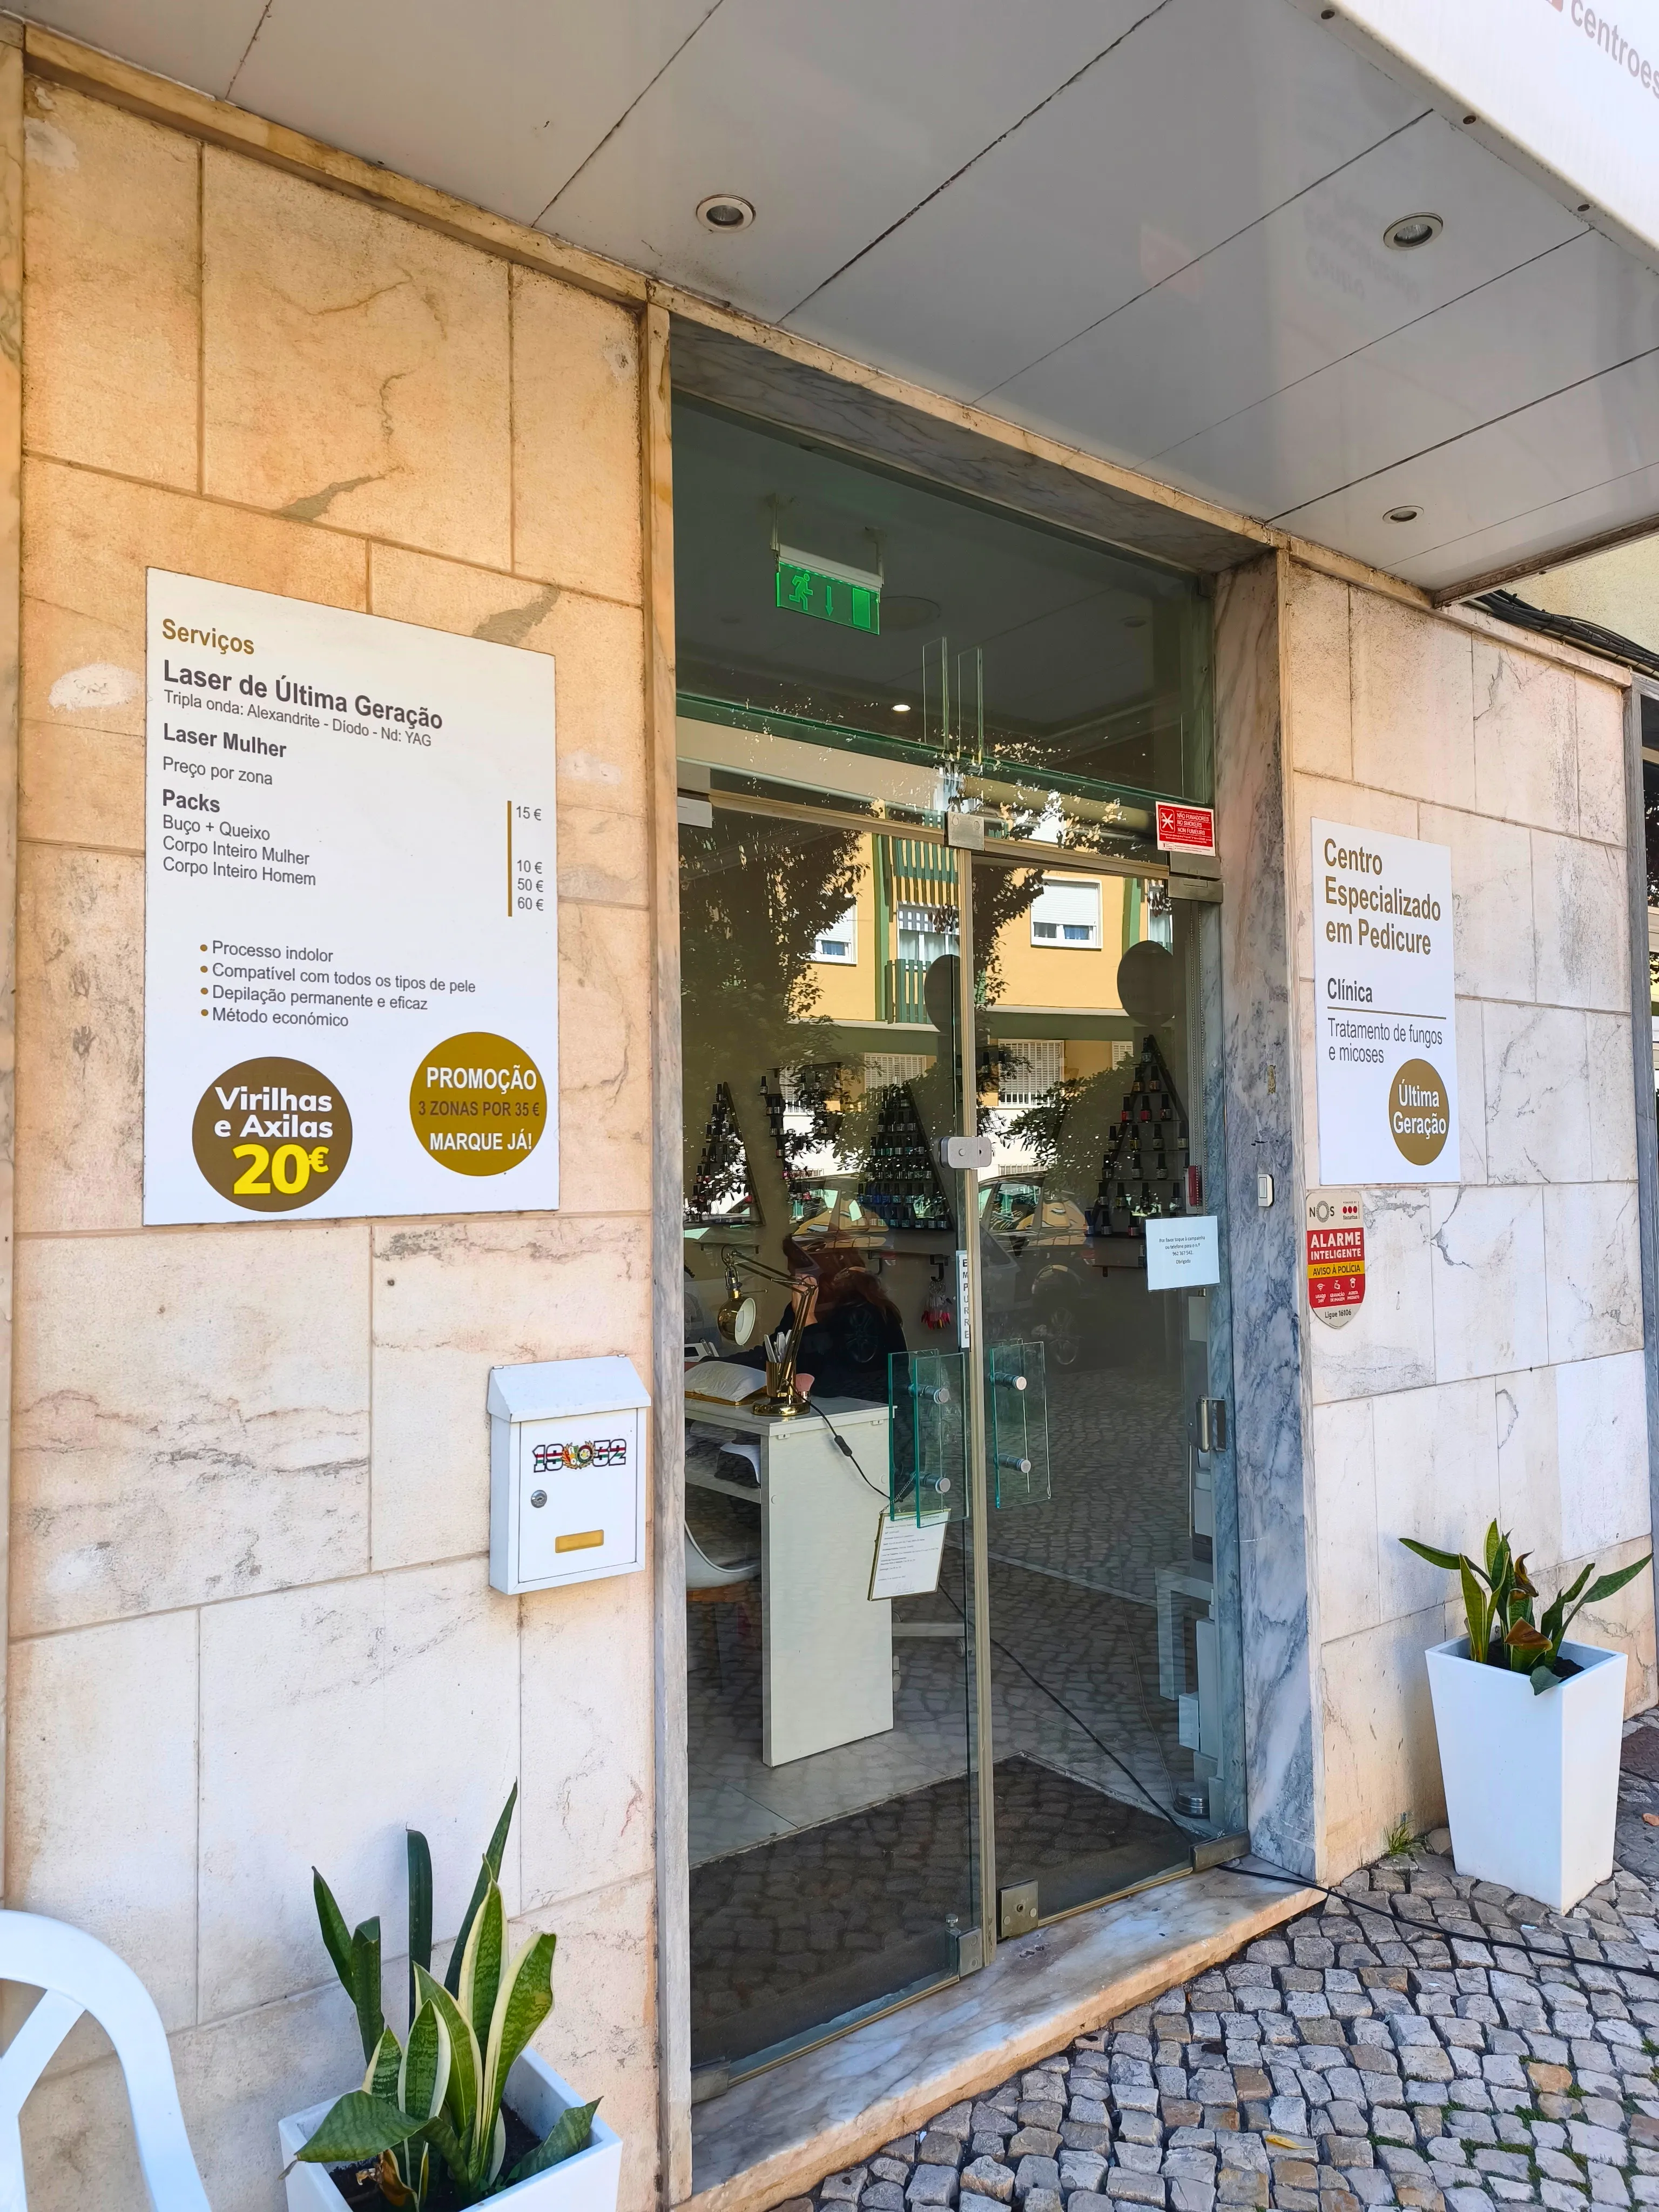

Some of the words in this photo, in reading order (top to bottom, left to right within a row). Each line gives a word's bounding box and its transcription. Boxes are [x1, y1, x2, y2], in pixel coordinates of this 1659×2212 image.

[163, 618, 254, 655] Serviços
[165, 659, 232, 691] Laser
[239, 675, 267, 698] de
[275, 675, 347, 712] Última
[355, 695, 442, 729] Geração
[164, 690, 201, 709] Tripla
[206, 700, 243, 715] onda:
[247, 704, 320, 727] Alexandrite
[381, 727, 401, 741] Nd:
[405, 731, 431, 746] YAG
[164, 723, 217, 746] Laser
[224, 732, 287, 757] Mulher
[164, 756, 205, 778] Preço
[211, 767, 234, 780] por
[238, 771, 272, 785] zona
[163, 789, 220, 812] Packs
[516, 806, 530, 819] 15
[534, 808, 541, 821] €
[164, 814, 200, 835] Buço
[206, 822, 214, 831] +
[220, 821, 270, 840] Queixo
[163, 835, 207, 856] Corpo
[214, 841, 257, 859] Inteiro
[262, 847, 310, 865] Mulher
[1325, 838, 1382, 875] Centro
[164, 857, 207, 876] Corpo
[214, 861, 257, 879] Inteiro
[263, 867, 315, 886] Homem
[517, 860, 531, 872] 10
[535, 862, 542, 874] €
[518, 878, 532, 891] 50
[536, 880, 543, 892] €
[518, 897, 532, 909] 60
[536, 899, 544, 911] €
[1326, 875, 1440, 921] Especializado
[1326, 921, 1352, 944] em
[1359, 919, 1431, 955] Pedicure
[213, 940, 281, 958] Processo
[286, 946, 333, 962] indolor
[213, 963, 295, 982] Compatível
[300, 972, 329, 983] com
[334, 972, 371, 986] todos
[376, 977, 391, 987] os
[395, 975, 426, 992] tipos
[430, 978, 445, 990] de
[450, 980, 475, 994] pele
[1327, 978, 1372, 1002] Clínica
[213, 985, 286, 1004] Depilação
[291, 993, 373, 1007] permanente
[377, 998, 385, 1007] e
[390, 996, 428, 1010] eficaz
[213, 1007, 267, 1023] Método
[273, 1012, 348, 1027] económico
[1328, 1017, 1390, 1041] Tratamento
[1394, 1023, 1406, 1042] de
[1409, 1024, 1442, 1048] fungos
[1329, 1047, 1335, 1060] e
[1339, 1043, 1384, 1063] micoses
[427, 1065, 536, 1094] PROMOÇÃO
[215, 1087, 332, 1111] Virilhas
[1399, 1078, 1439, 1108] Última
[419, 1101, 426, 1115] 3
[430, 1101, 478, 1116] ZONAS
[483, 1102, 511, 1116] POR
[515, 1102, 529, 1116] 35
[532, 1102, 539, 1116] €
[215, 1121, 231, 1137] e
[240, 1114, 332, 1137] Axilas
[1393, 1111, 1446, 1140] Geração
[430, 1133, 502, 1151] MARQUE
[508, 1129, 531, 1149] JÁ!
[1309, 1201, 1334, 1223] NOS
[1311, 1232, 1361, 1248] ALARME
[1311, 1248, 1361, 1260] INTELIGENTE
[1313, 1267, 1331, 1276] AVISO
[1338, 1263, 1360, 1273] POLÍCIA
[1325, 1311, 1338, 1319] Ligue
